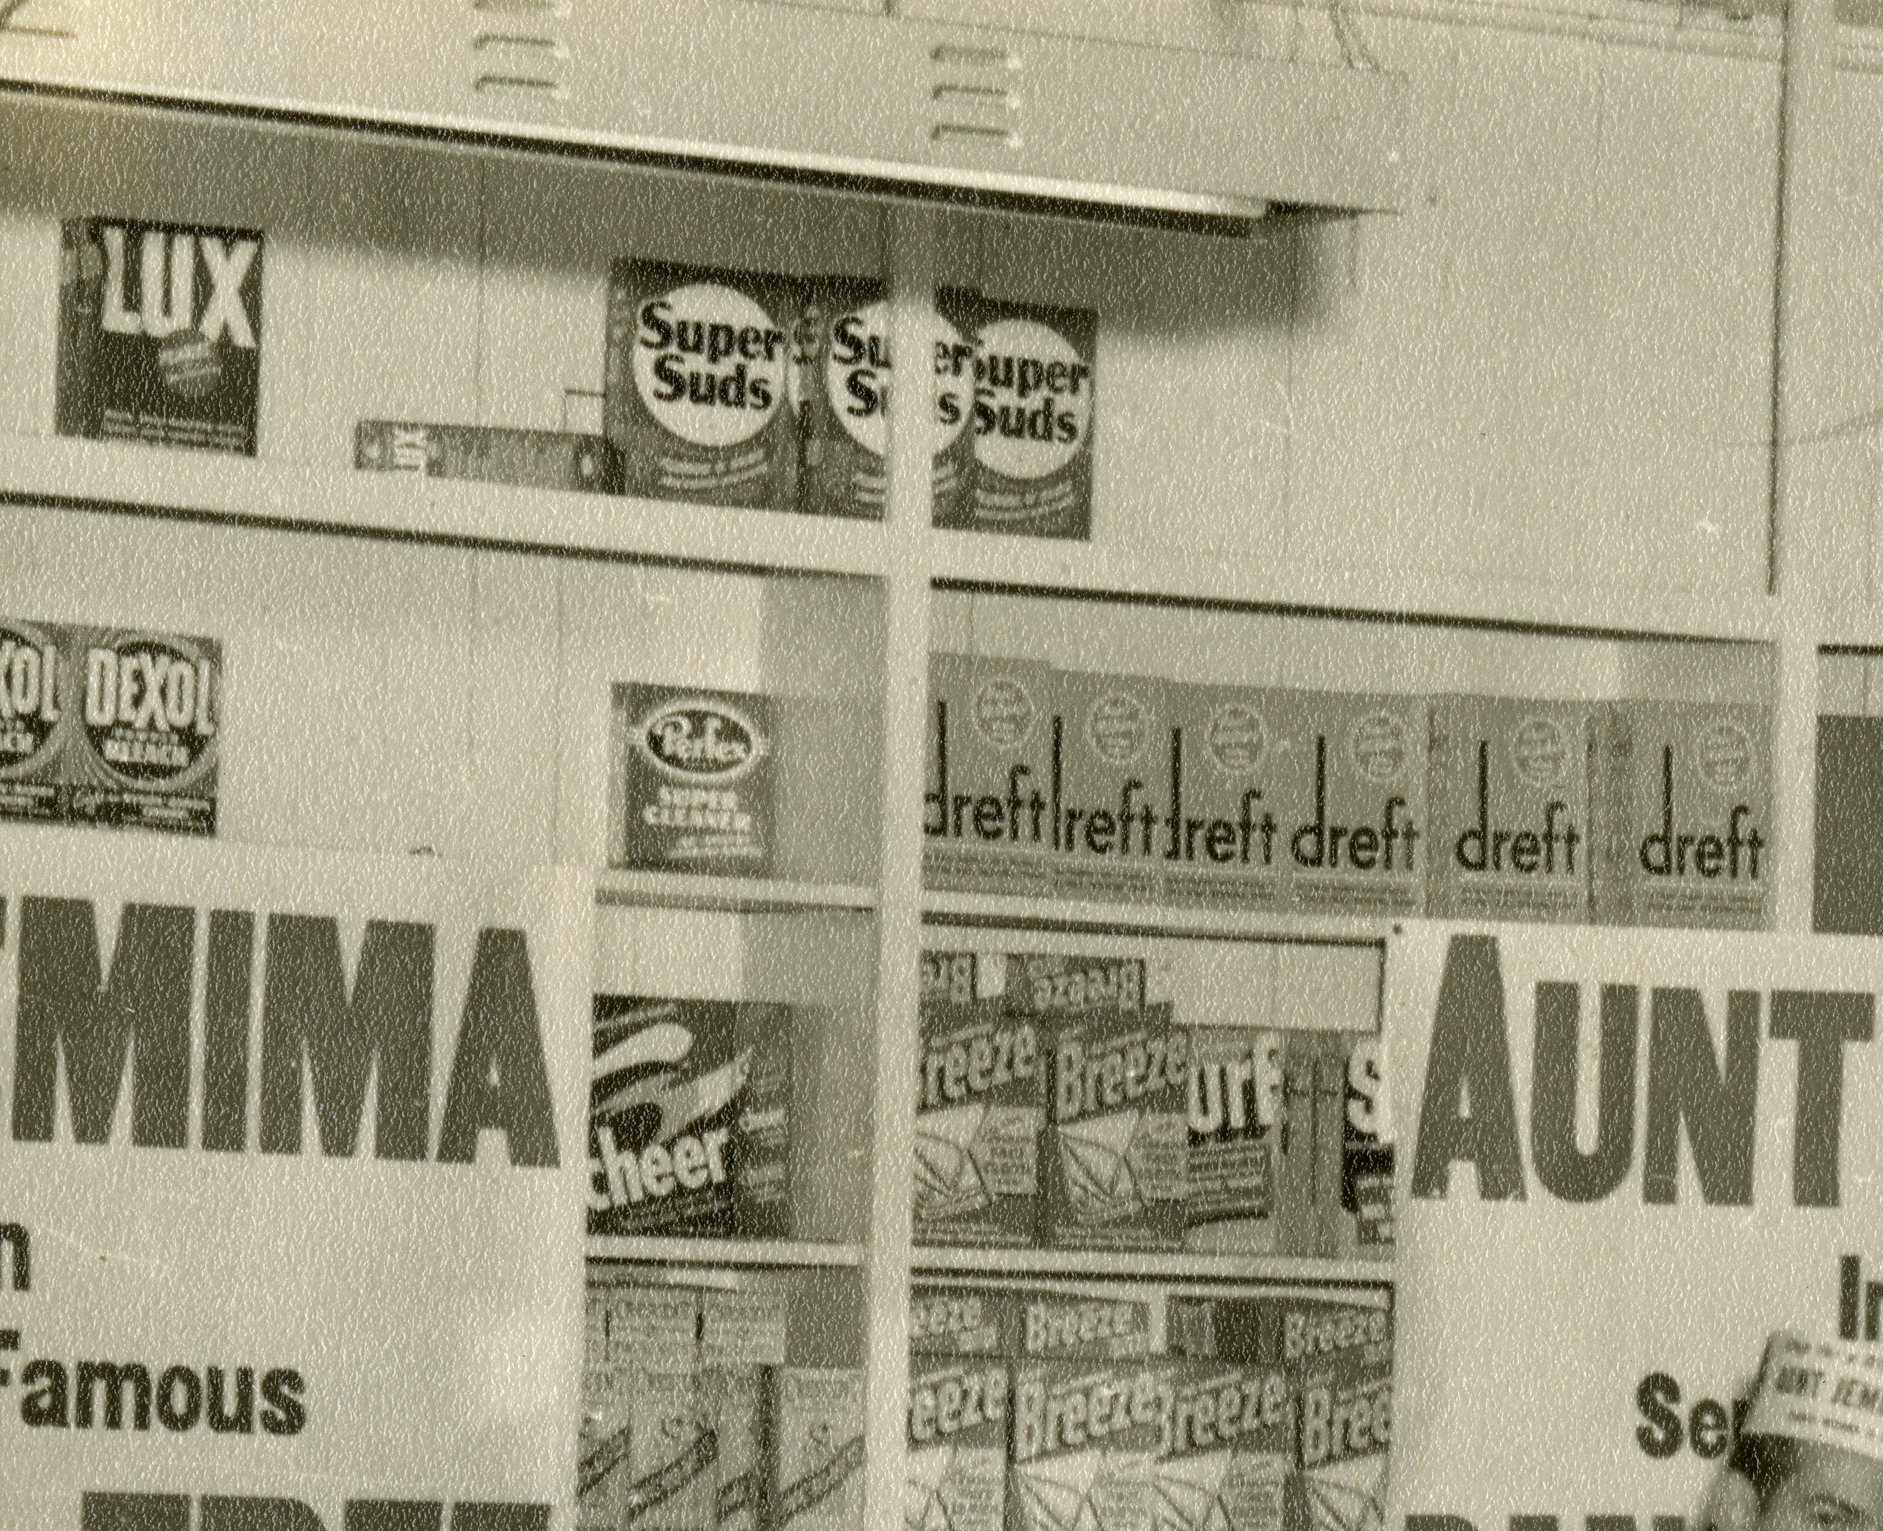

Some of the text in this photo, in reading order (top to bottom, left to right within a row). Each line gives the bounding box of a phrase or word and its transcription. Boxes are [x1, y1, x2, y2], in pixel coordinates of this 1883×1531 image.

[99, 226, 258, 348] LUX
[639, 299, 786, 363] Super
[652, 355, 773, 411] Suds
[832, 316, 973, 380] Suer
[86, 647, 214, 735] DEXOL
[1290, 734, 1420, 873] dreft
[1455, 740, 1579, 876] dreft
[1639, 745, 1765, 881] dreft
[0, 893, 562, 1168] MIMA
[924, 1024, 1036, 1106] reeze
[1056, 1032, 1188, 1120] Breeze
[1411, 935, 1875, 1207] AUNT
[1187, 1032, 1284, 1133] urf
[1026, 1302, 1134, 1352] Breeze
[0, 1329, 306, 1435] amous
[1017, 1372, 1154, 1459] Breeze
